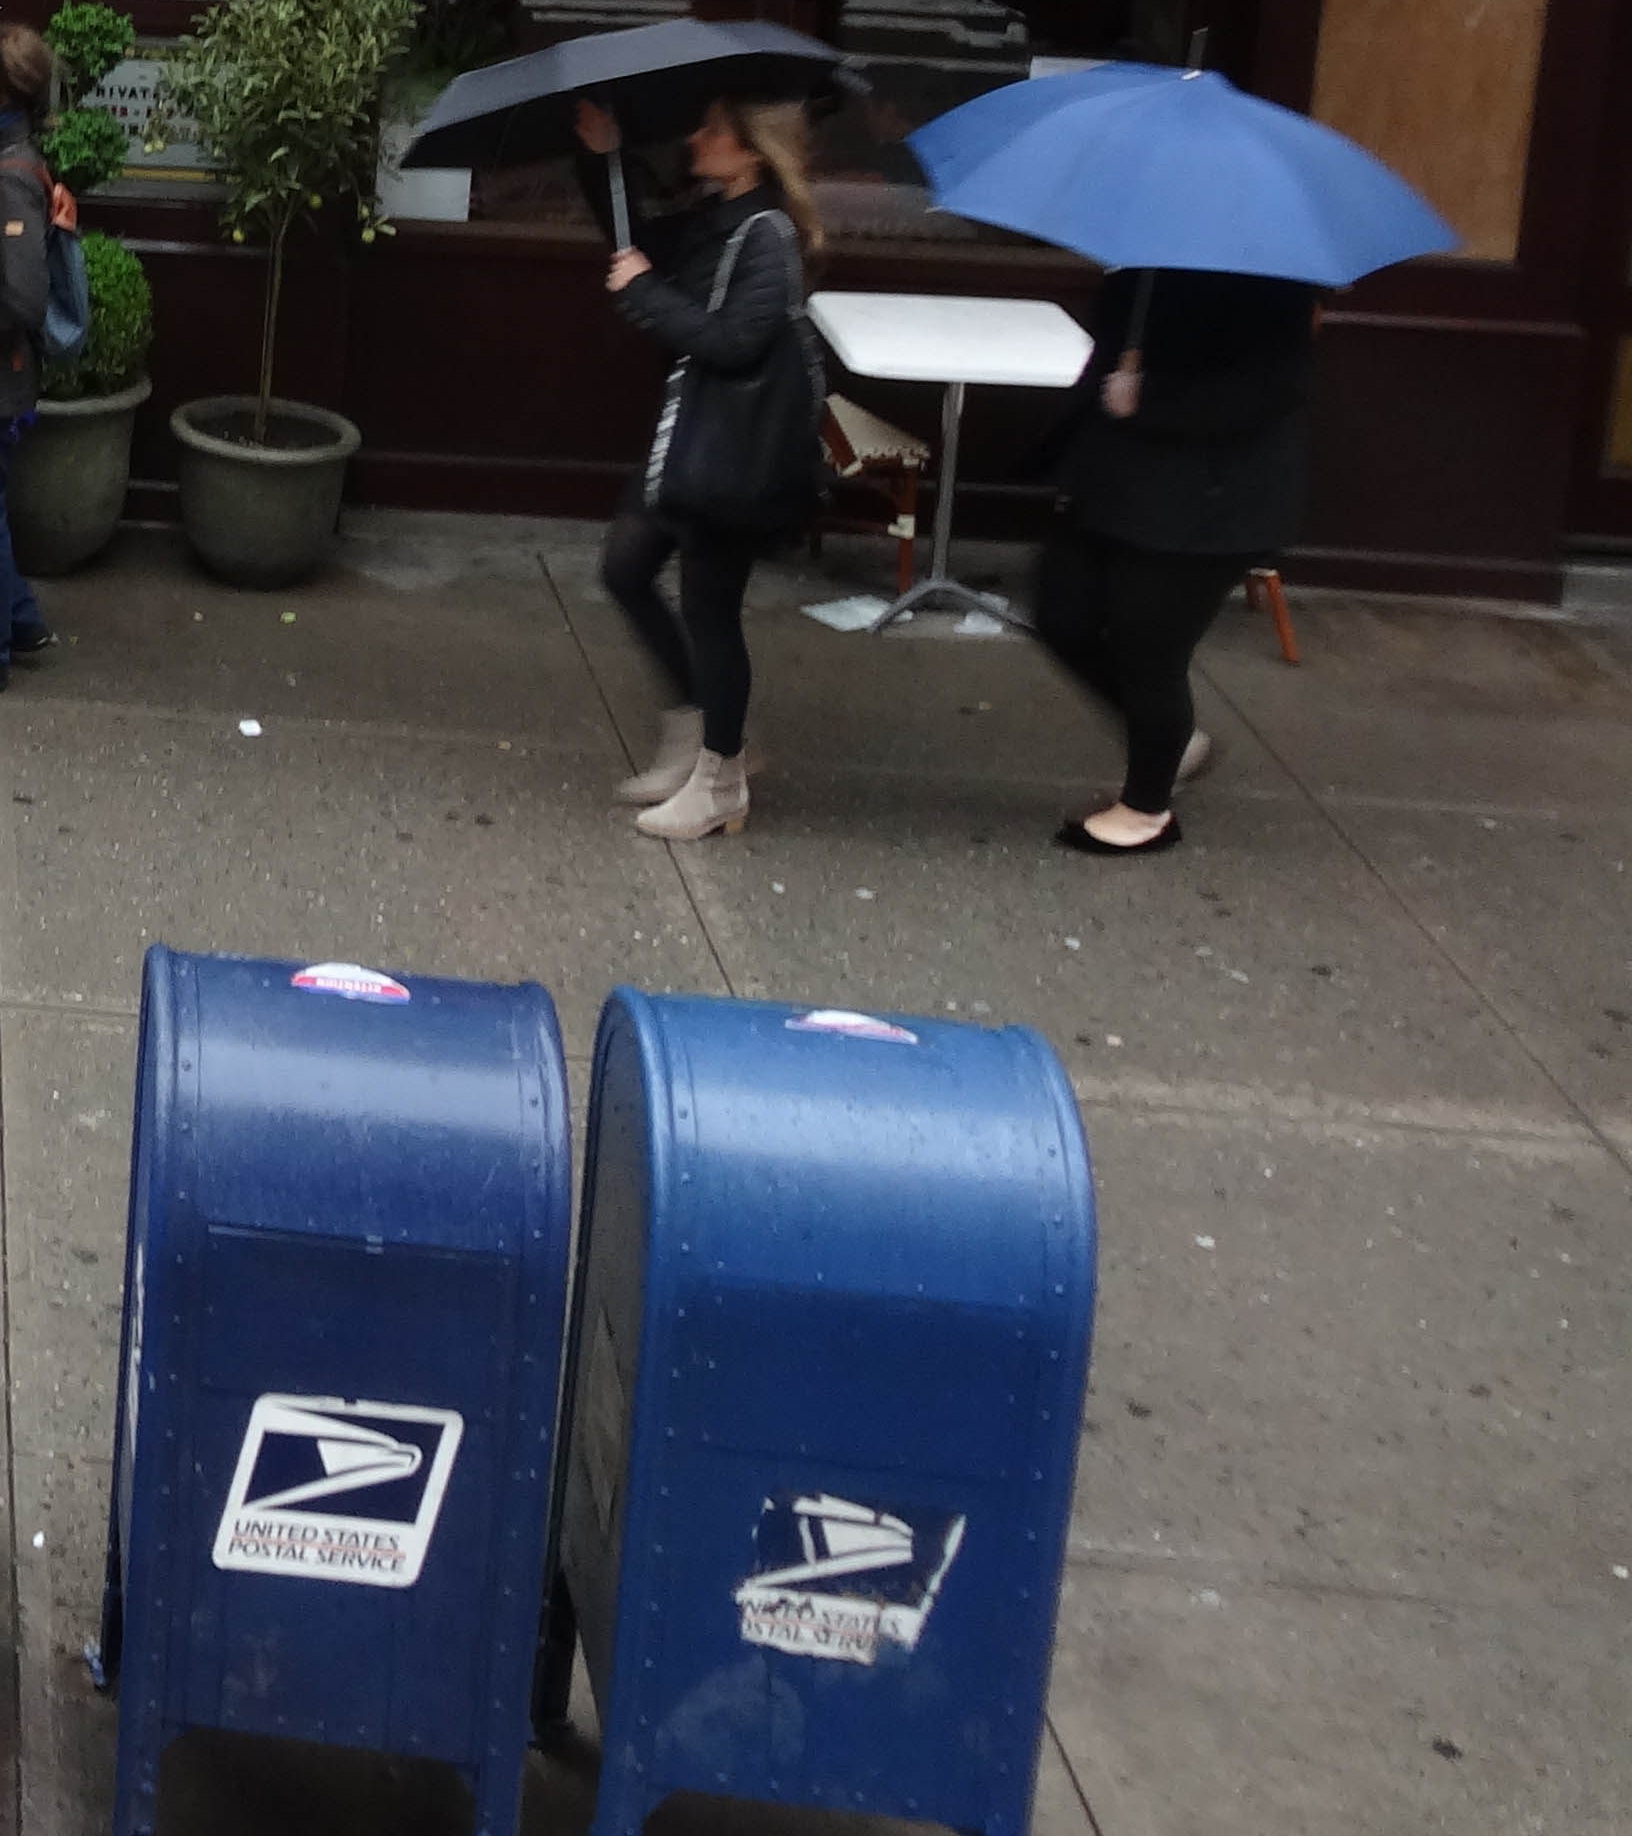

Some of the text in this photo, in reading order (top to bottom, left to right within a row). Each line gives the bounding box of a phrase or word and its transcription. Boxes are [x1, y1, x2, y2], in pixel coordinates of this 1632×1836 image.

[234, 1518, 401, 1552] UNITED STATES
[228, 1538, 403, 1573] POSTAL SERVICE
